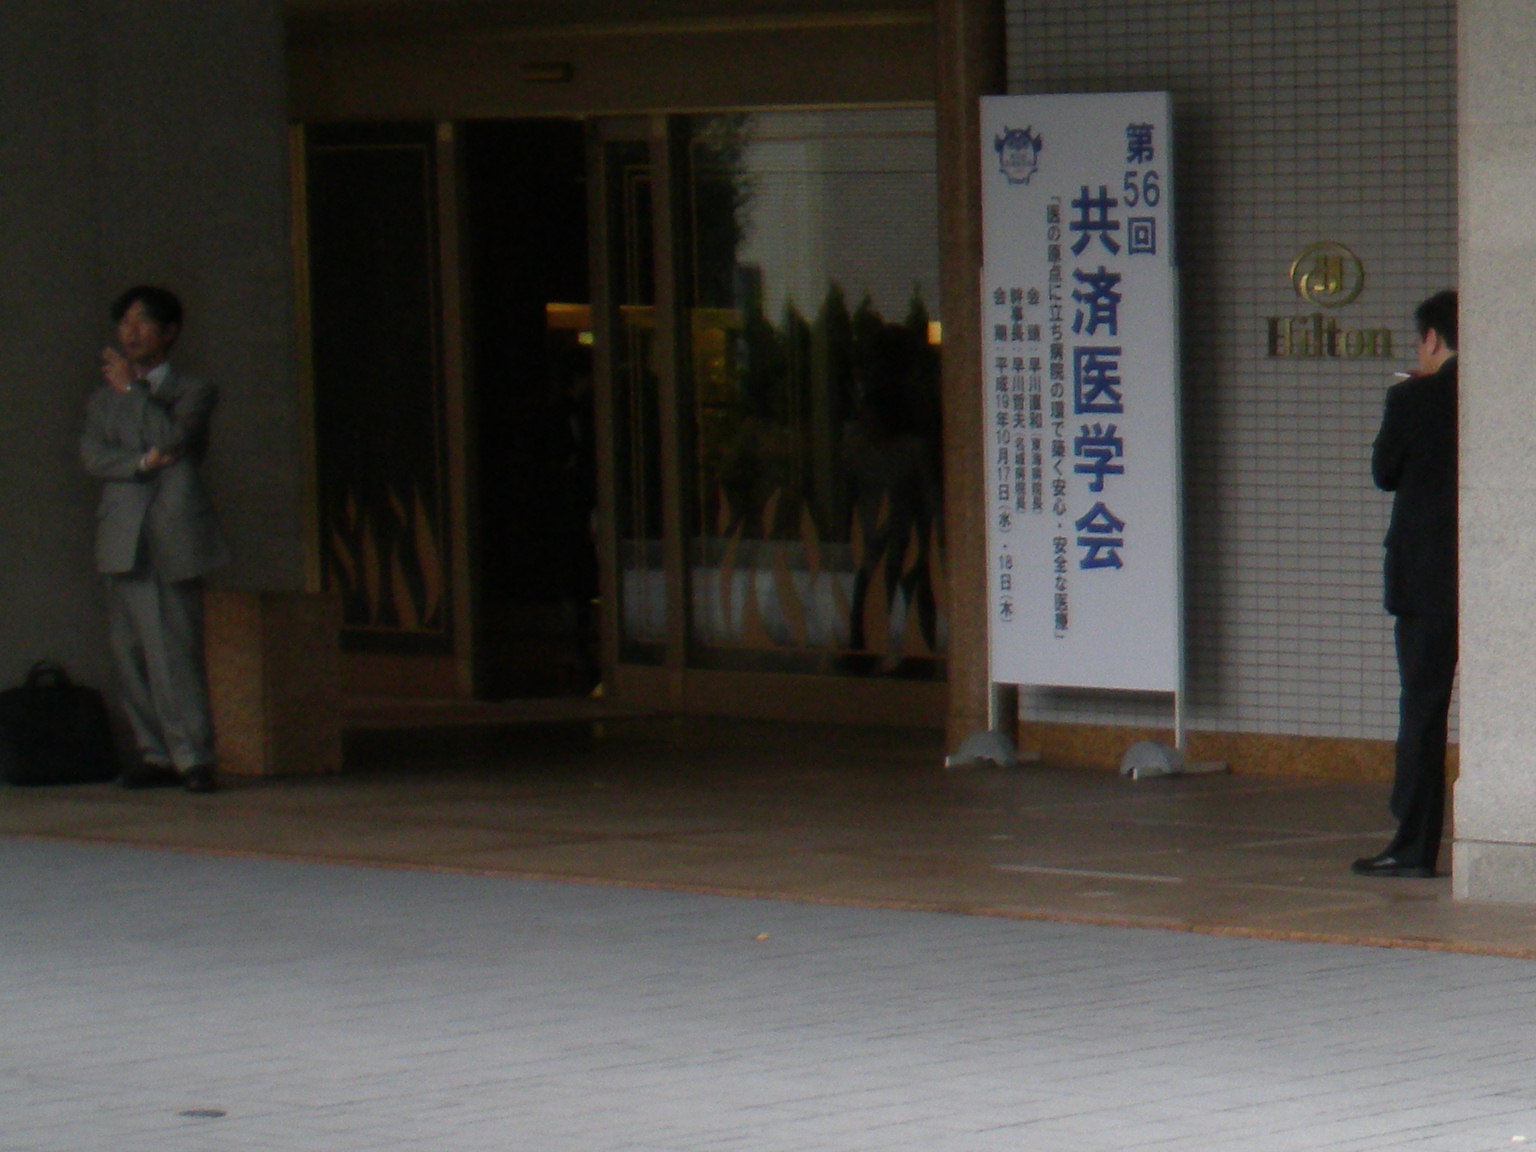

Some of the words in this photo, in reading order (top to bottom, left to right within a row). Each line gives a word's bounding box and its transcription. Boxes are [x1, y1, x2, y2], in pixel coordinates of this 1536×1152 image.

[1123, 121, 1161, 256] 第56回
[1069, 184, 1126, 571] 共済医学会
[1265, 311, 1395, 359] Hilton
